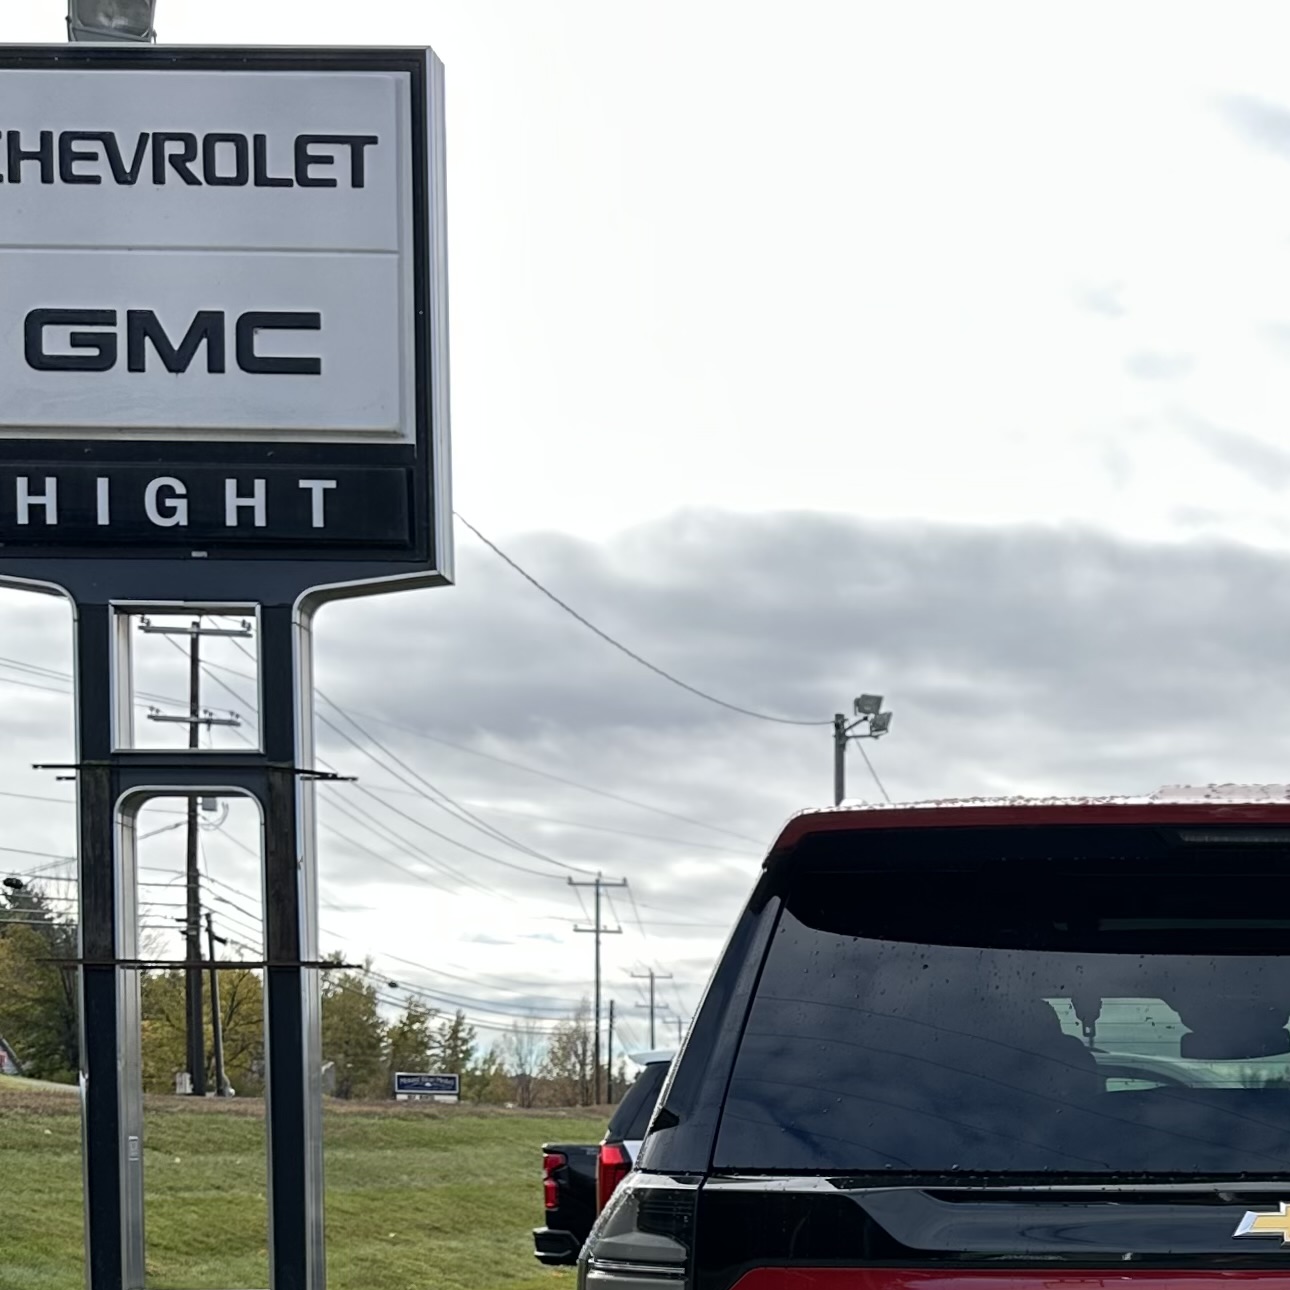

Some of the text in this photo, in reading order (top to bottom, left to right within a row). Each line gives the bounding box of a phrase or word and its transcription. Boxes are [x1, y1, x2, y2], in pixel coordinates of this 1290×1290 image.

[0, 130, 378, 188] HEVROLET
[24, 308, 321, 375] GMC
[16, 476, 336, 528] HIGHT
